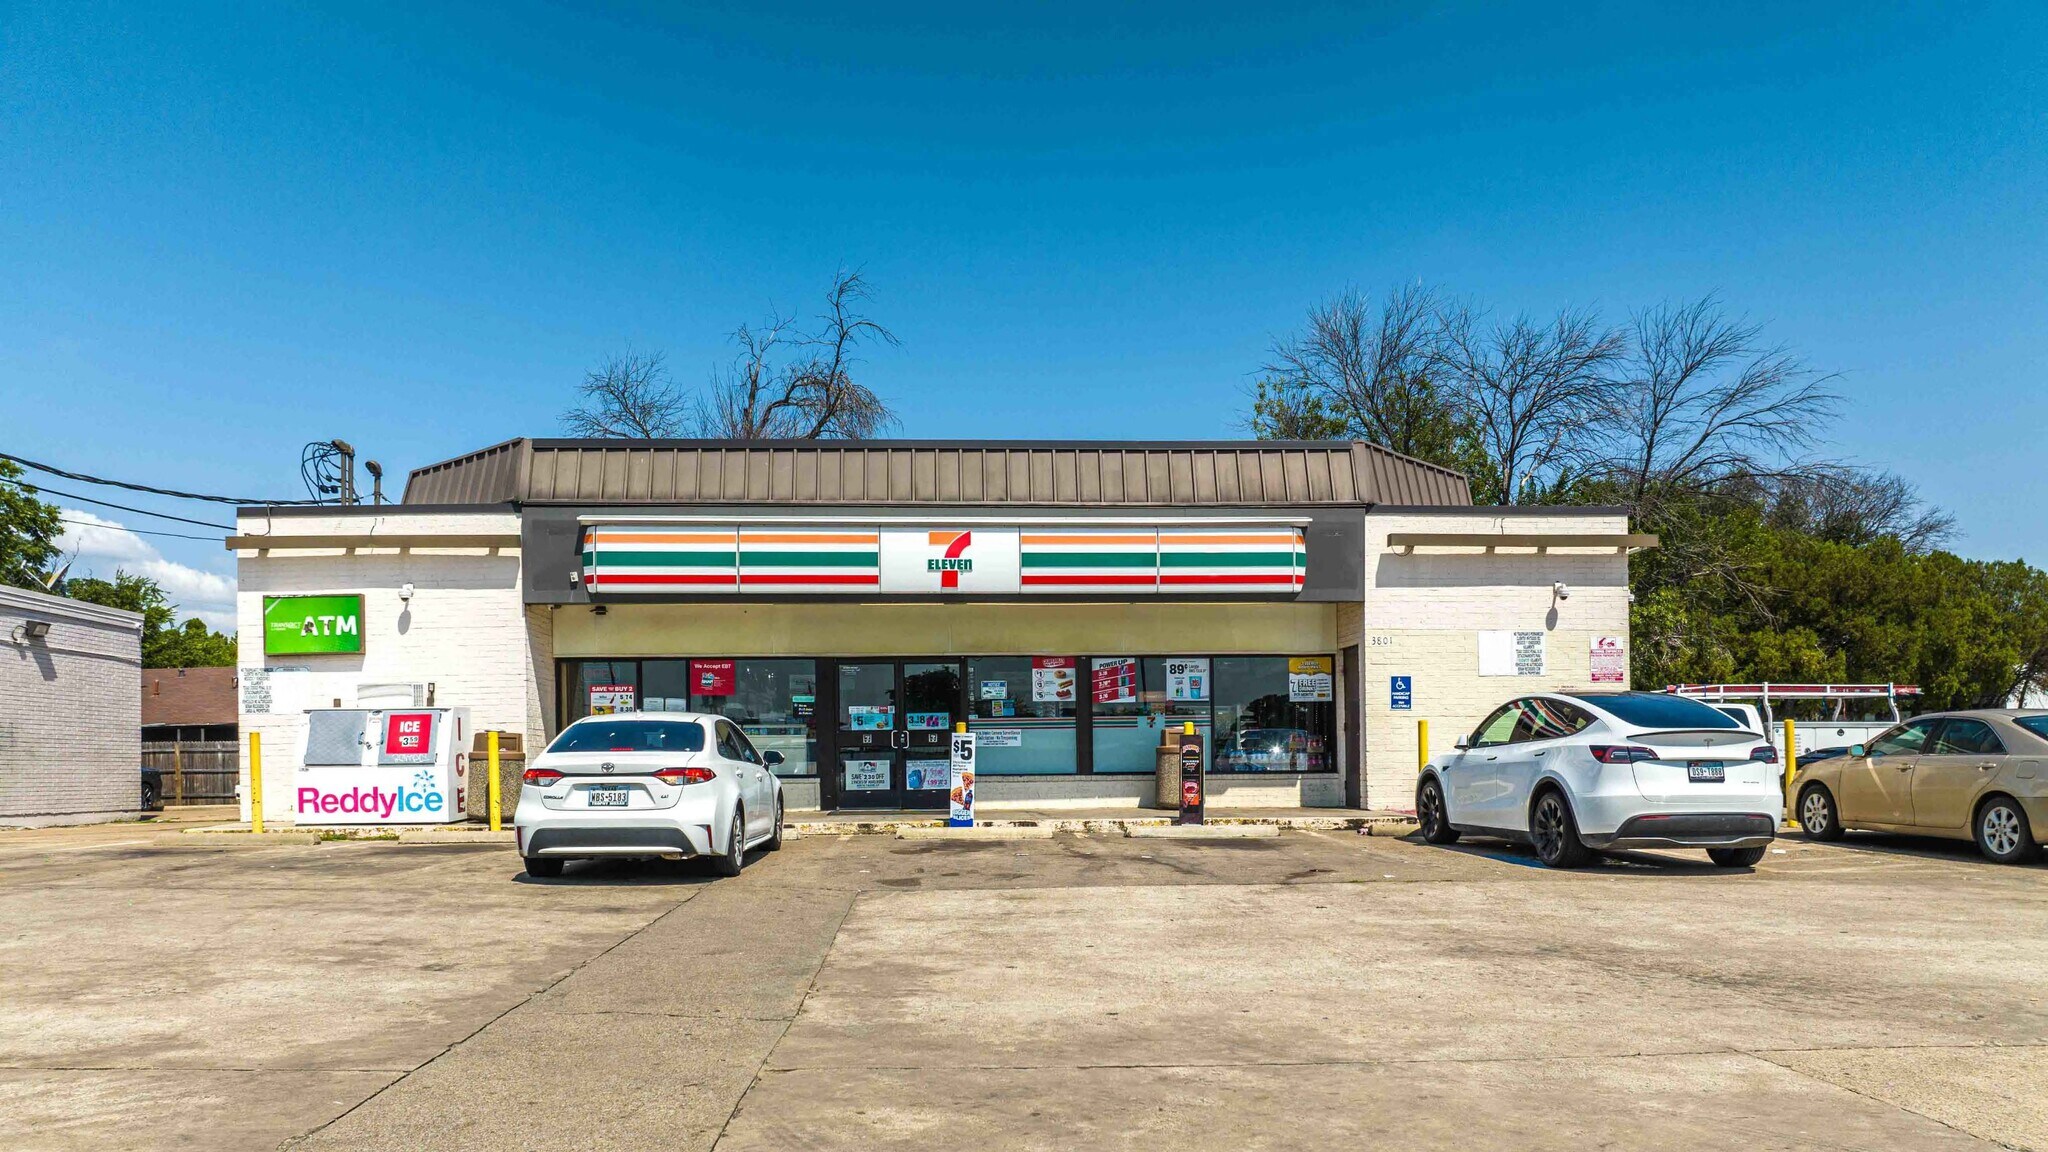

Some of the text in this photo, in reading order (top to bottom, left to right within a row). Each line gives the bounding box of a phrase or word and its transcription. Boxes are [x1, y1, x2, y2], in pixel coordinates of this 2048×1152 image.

[928, 531, 971, 588] 7
[300, 615, 357, 636] ATM
[400, 721, 420, 732] ICE
[953, 740, 972, 760] $5
[455, 717, 466, 813] ICE
